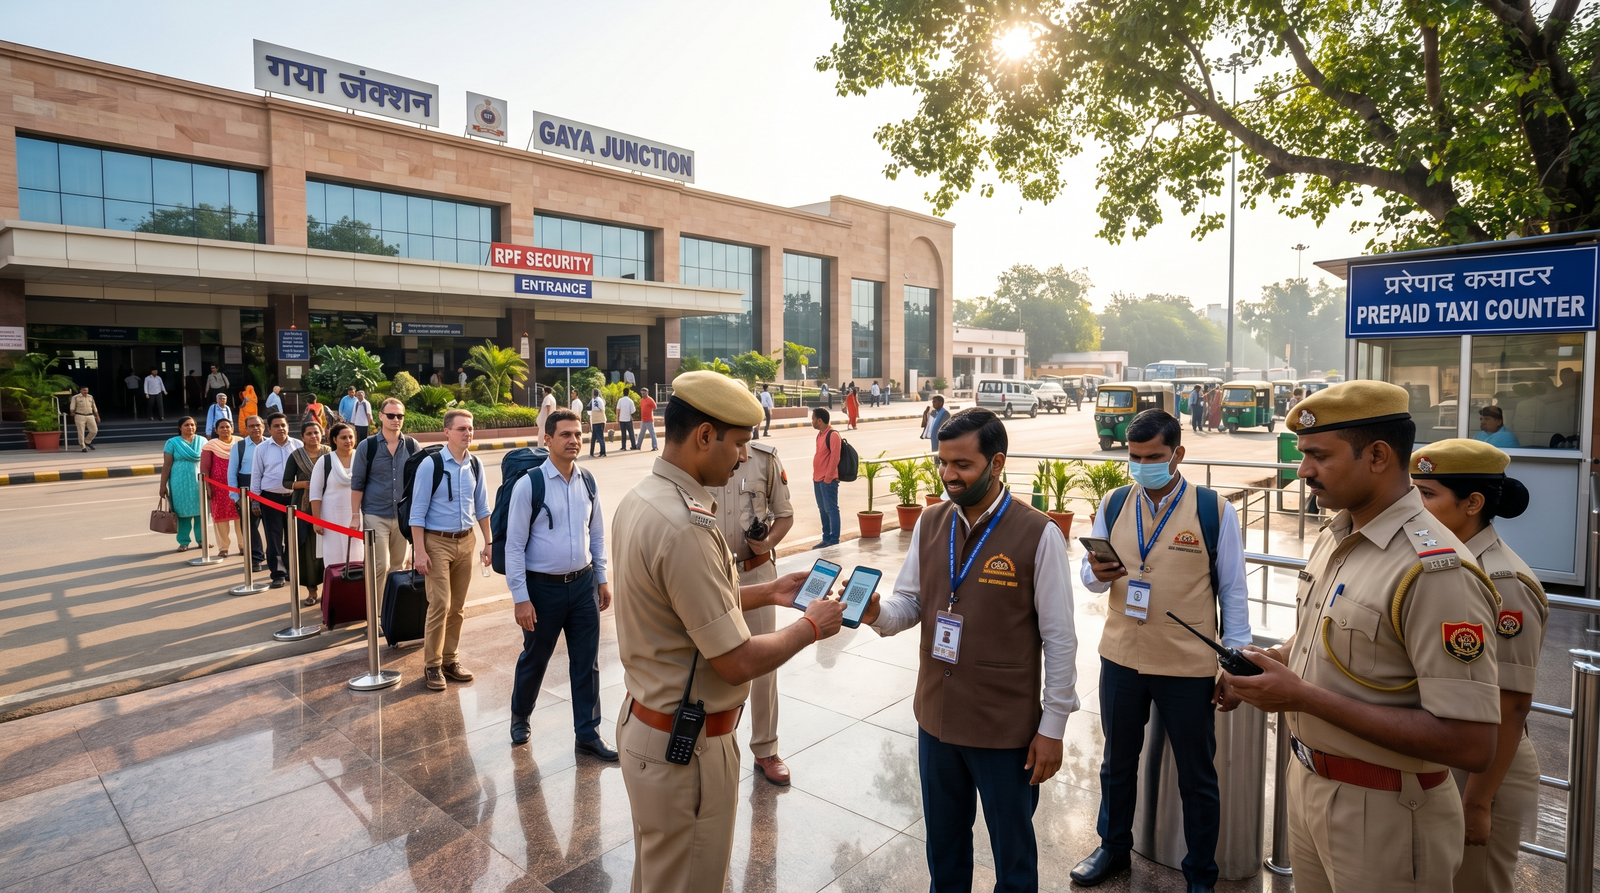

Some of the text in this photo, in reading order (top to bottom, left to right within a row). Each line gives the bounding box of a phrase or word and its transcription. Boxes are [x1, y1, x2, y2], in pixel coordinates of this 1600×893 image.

[266, 55, 432, 117] गया जंक्शन
[539, 120, 692, 177] GAYA JUNCTION
[495, 247, 591, 272] RPF SECURITY
[521, 279, 587, 295] ENTRANCE
[1357, 295, 1585, 325] PREPAID TAXI COUNTER
